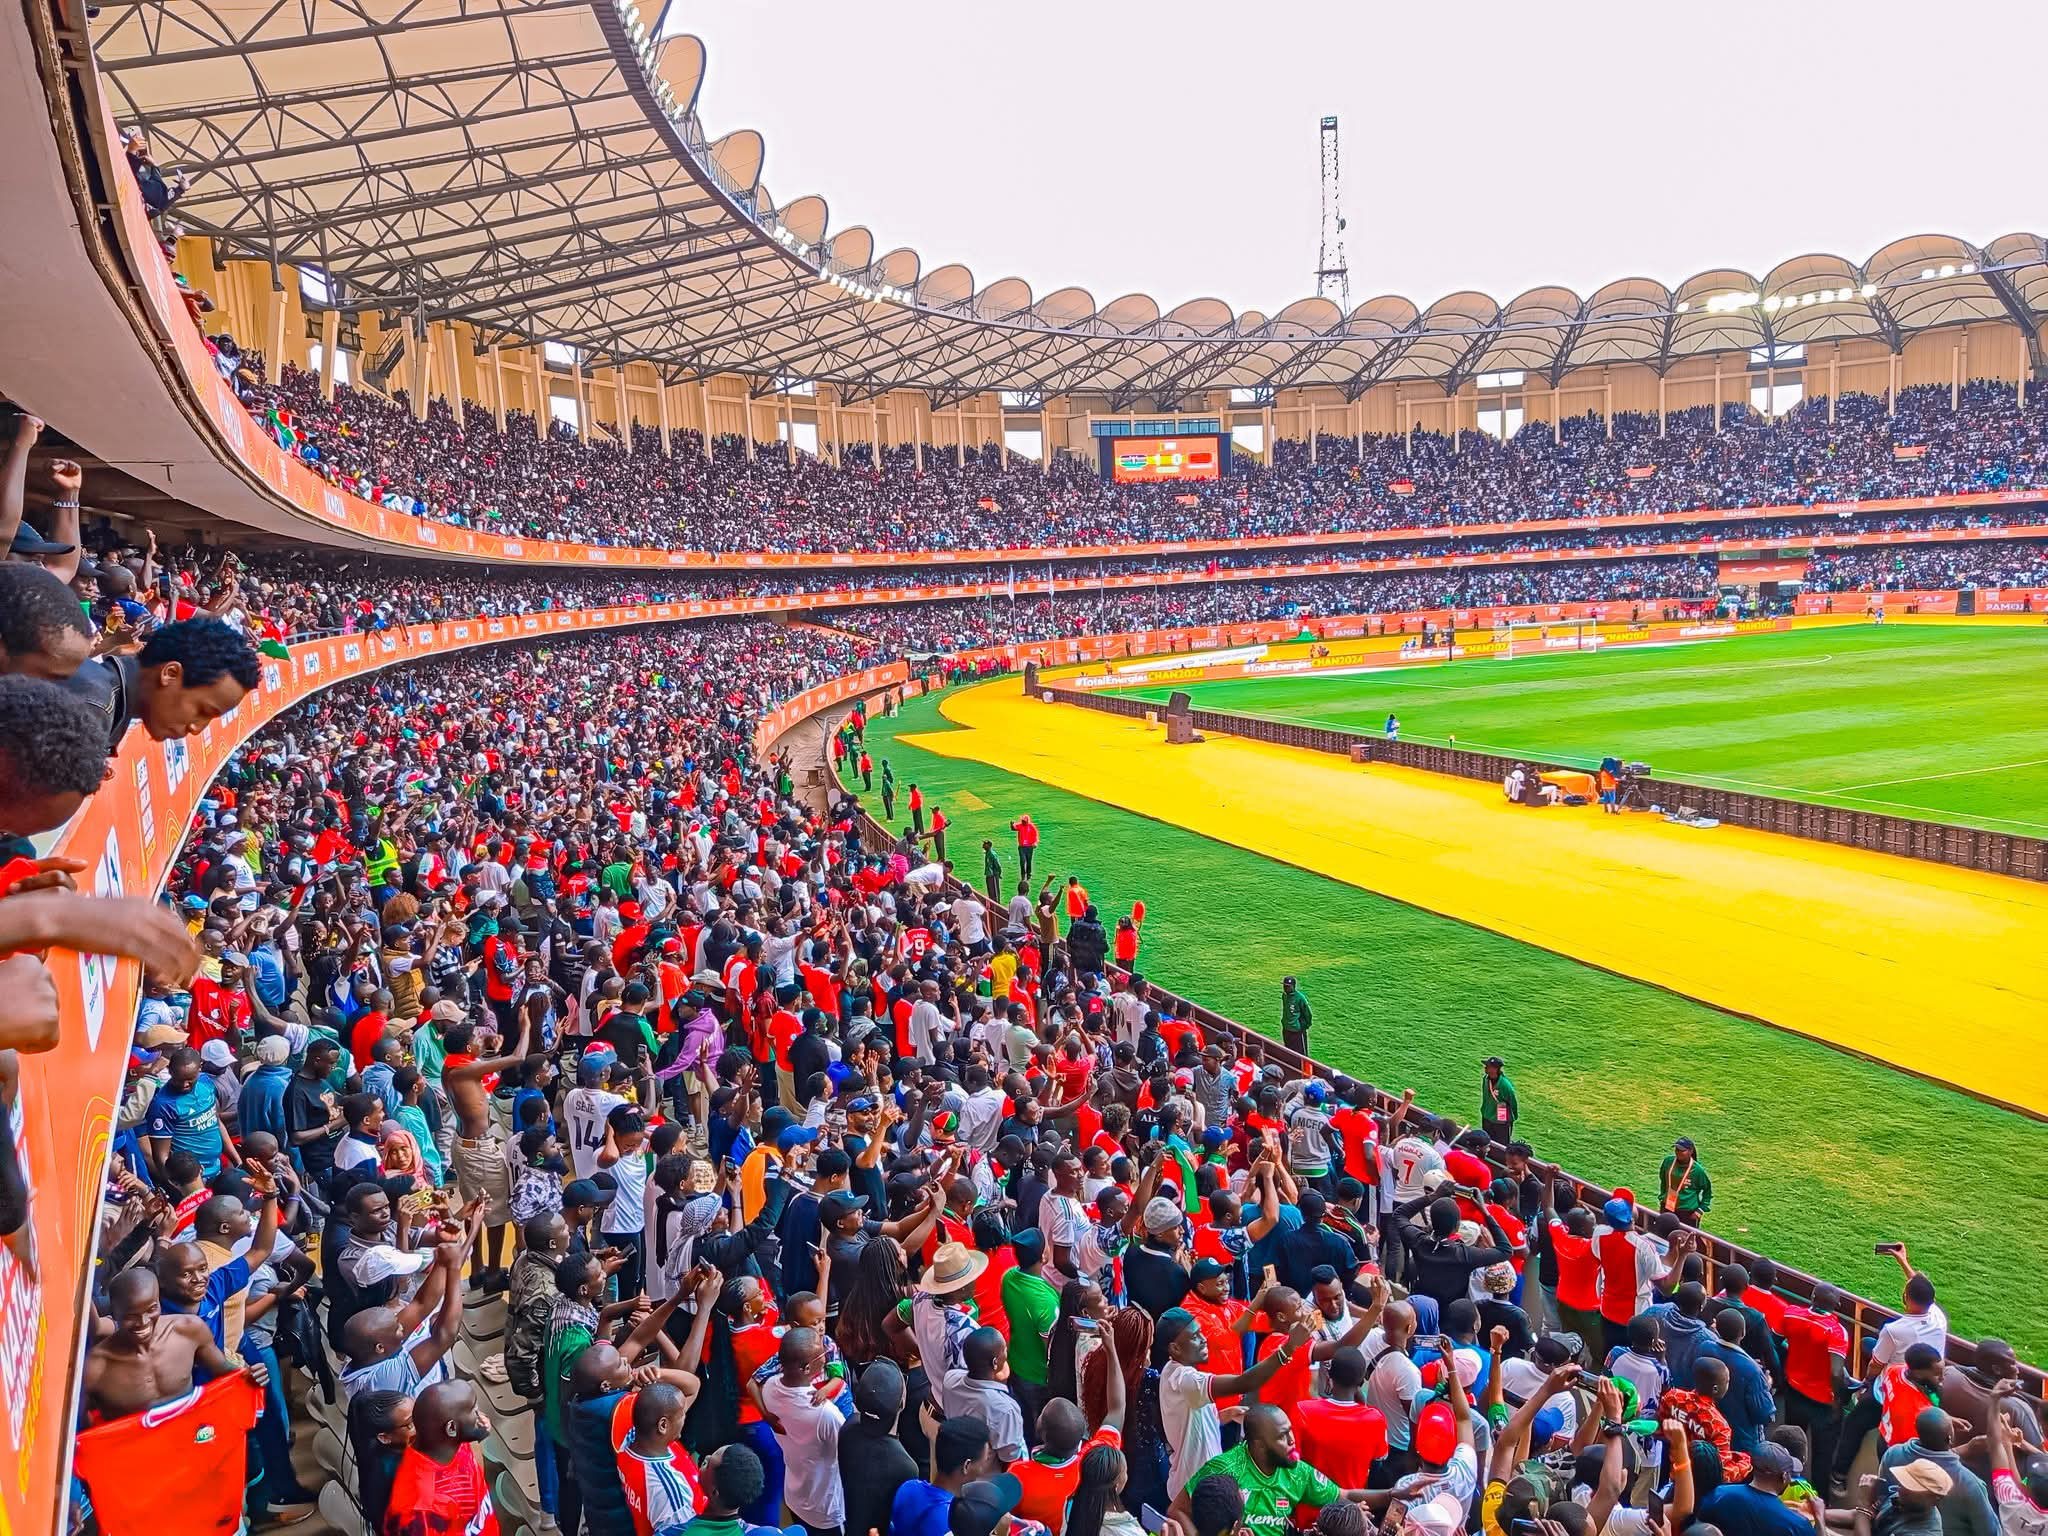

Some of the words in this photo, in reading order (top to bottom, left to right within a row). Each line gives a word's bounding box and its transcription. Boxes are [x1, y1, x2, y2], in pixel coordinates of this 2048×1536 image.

[1731, 565, 1791, 573] CAF
[573, 1115, 600, 1153] 14
[1403, 1159, 1415, 1185] 7
[1243, 1512, 1286, 1528] Kenya
